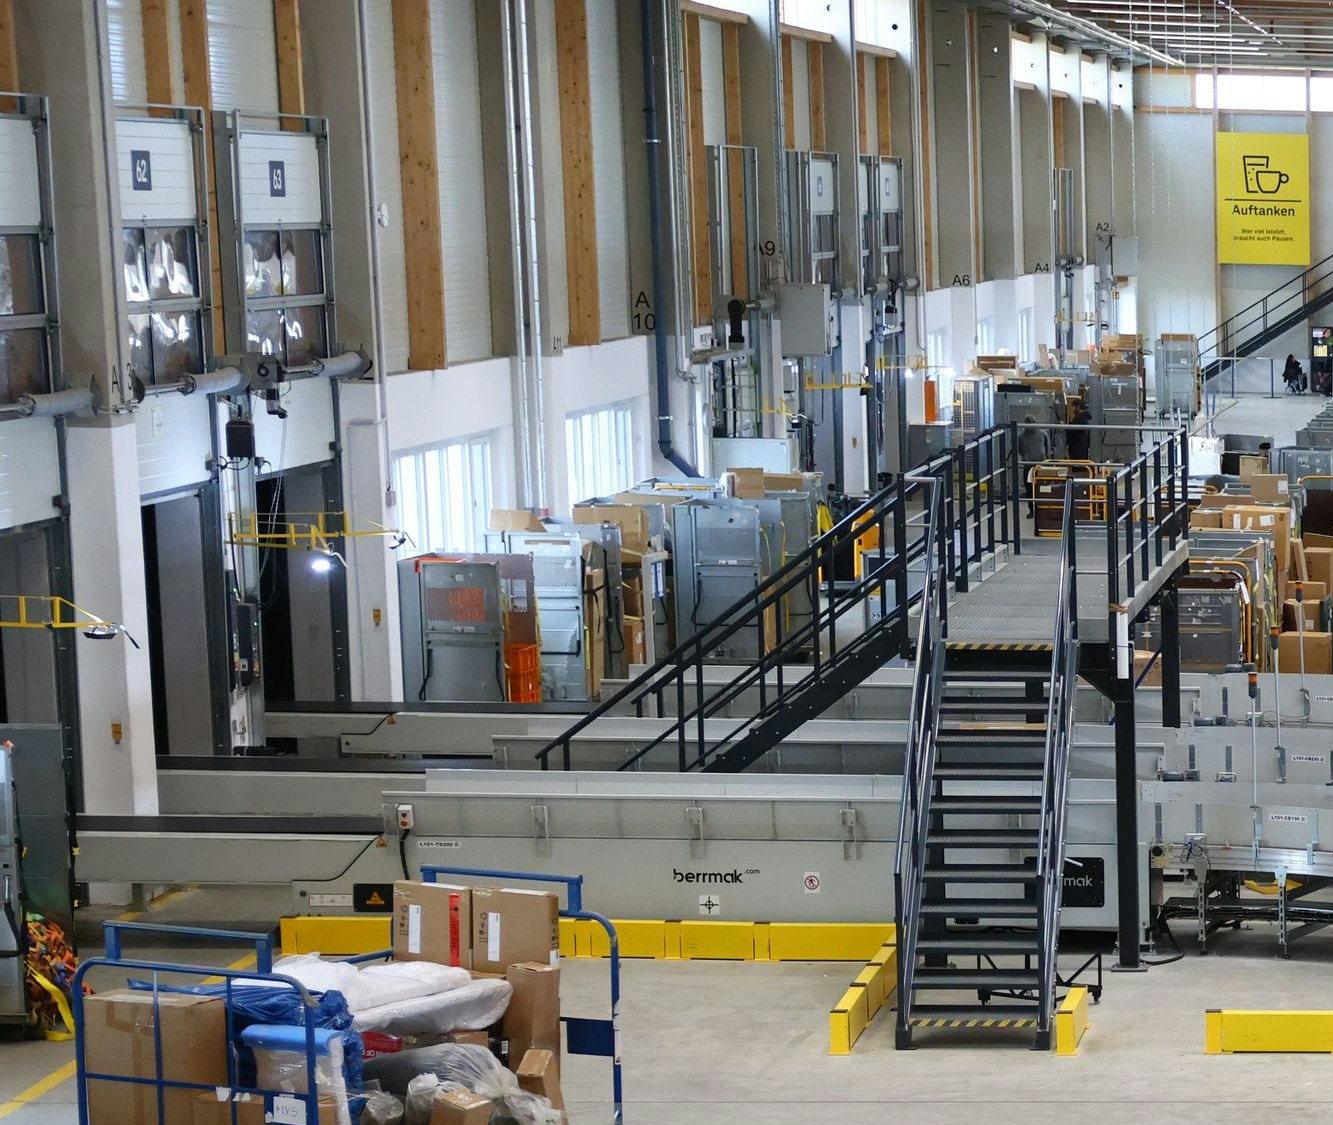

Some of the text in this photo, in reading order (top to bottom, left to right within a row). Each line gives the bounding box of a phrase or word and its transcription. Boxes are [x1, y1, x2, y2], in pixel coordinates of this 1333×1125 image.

[136, 159, 148, 183] 62
[272, 168, 282, 190] 63
[1232, 204, 1296, 216] Auftanken
[1096, 223, 1109, 232] A2
[1034, 263, 1050, 273] A4
[952, 275, 971, 286] A6
[635, 291, 650, 308] A
[632, 313, 656, 331] 10
[673, 868, 744, 884] berrmak
